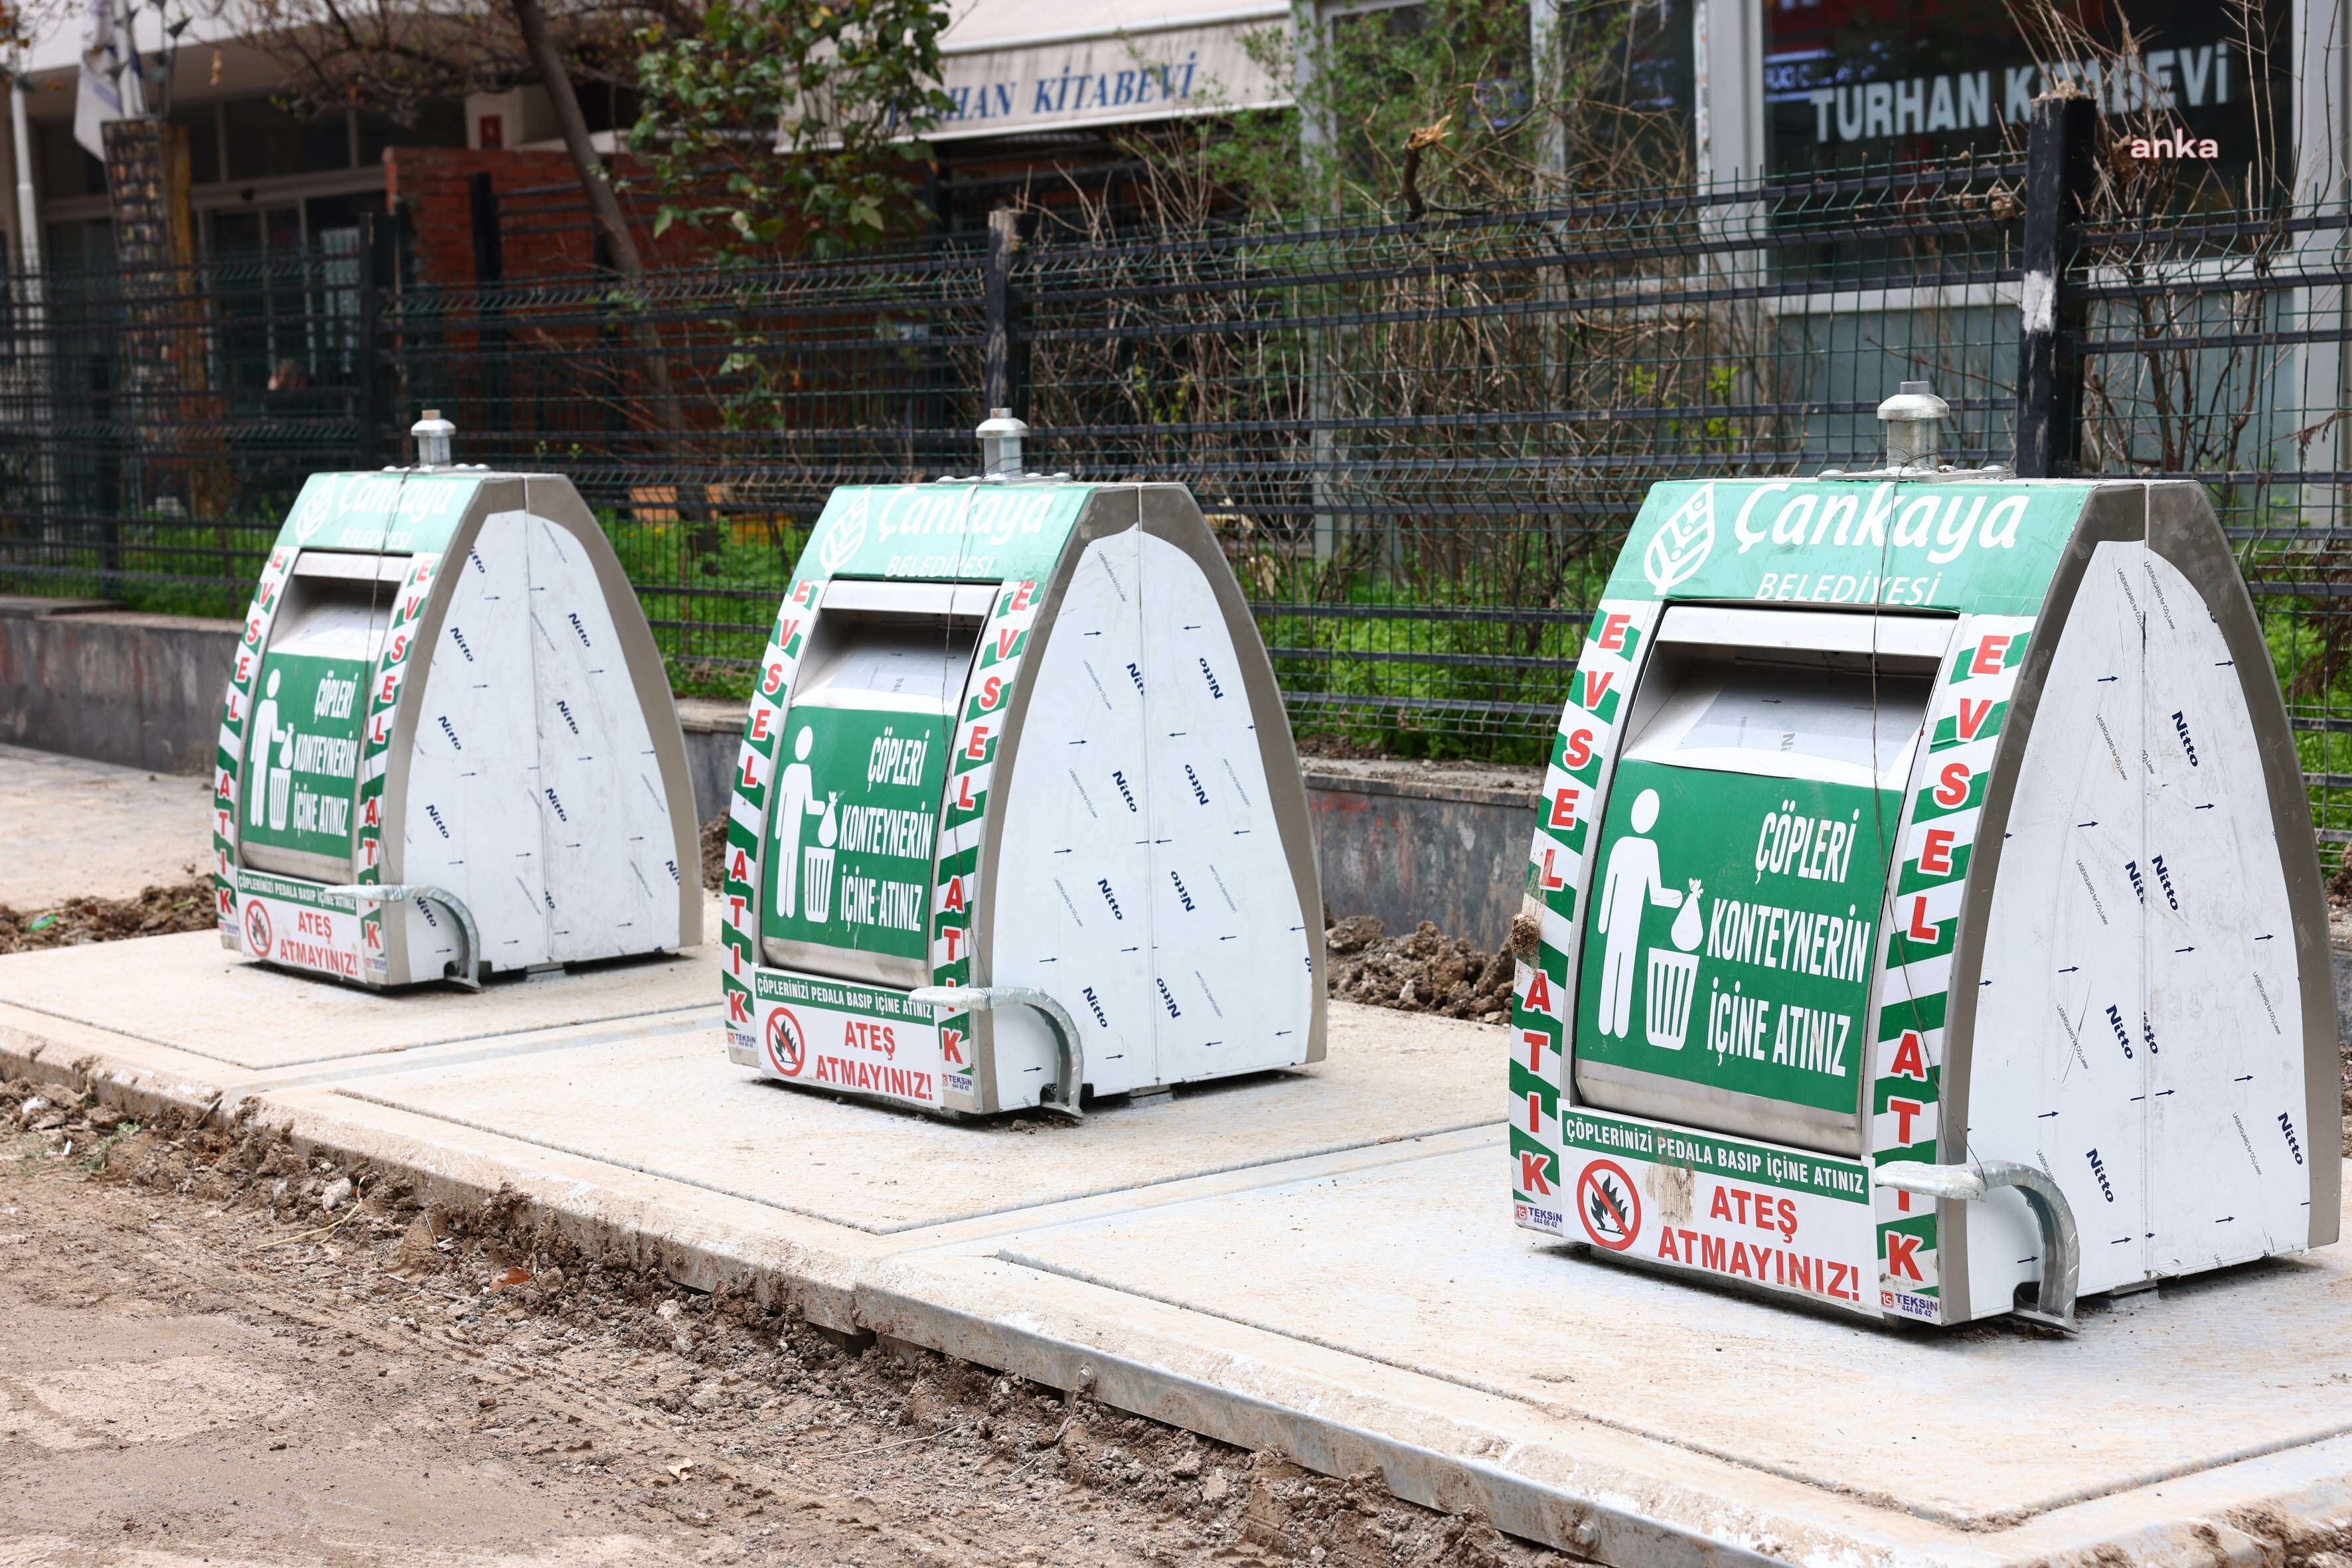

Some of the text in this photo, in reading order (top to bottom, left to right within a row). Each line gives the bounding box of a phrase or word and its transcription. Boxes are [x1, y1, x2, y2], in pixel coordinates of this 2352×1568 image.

[888, 82, 1017, 127] THAN
[1810, 70, 1990, 143] TURHAN
[337, 474, 458, 524] Çankaya
[878, 485, 1055, 546] Çankaya
[1735, 482, 2030, 564] Çankaya
[469, 546, 485, 574] itto
[885, 552, 996, 578] BELEDİYESİ
[1756, 570, 1942, 605] BELEDİYESİ
[450, 627, 473, 662] Nitto
[568, 613, 590, 647] Nitto
[313, 670, 358, 724] ÇÖPLERİ
[1126, 662, 1144, 696] Nit
[1199, 657, 1224, 700] Nitto
[437, 716, 461, 750] Nitto
[556, 700, 579, 735] Nitto
[2171, 710, 2198, 767] Nitto
[293, 730, 358, 779] KONTEYNERİN
[867, 726, 929, 793] ÇÖPLERİ
[545, 788, 567, 822] Nitto
[1112, 770, 1137, 813] Nitto
[1184, 764, 1210, 806] Nitto
[1912, 635, 2010, 941] EVSEL
[293, 782, 349, 838] İÇİNE ATINIZ
[426, 805, 449, 838] Nitto
[839, 801, 934, 860] KONTEYNERİN
[1755, 799, 1859, 884] ÇÖPLERİ
[840, 864, 923, 933] İÇİNE ATINIZ
[1097, 878, 1123, 920] Nitto
[1170, 871, 1196, 912] Nitto
[2124, 860, 2144, 904] Nit
[2151, 854, 2178, 911] Nitto
[298, 911, 332, 945] ATEŞ
[1707, 898, 1870, 984] KONTEYNERİN
[279, 939, 358, 976] ATMAYINIZ!
[757, 974, 932, 1019] ÇÖPLERİNİZİ PEDALA BASIP İÇİNE ATINIZ
[1082, 986, 1108, 1028] Nitto
[1156, 978, 1182, 1019] Nitto
[844, 1020, 896, 1061] ATEŞ
[1707, 978, 1851, 1077] İÇİNE ATINIZ
[2105, 1004, 2133, 1059] Nitto
[817, 1055, 933, 1100] ATMAYINIZ!
[1567, 1117, 1864, 1194] ÇÖPLERİNİZİ PEDALA BASIP İÇİNE ATINIZ
[2277, 1111, 2303, 1165] Nitto
[2085, 1148, 2114, 1203] Nitto
[1710, 1185, 1798, 1243] ATEŞ
[1658, 1227, 1859, 1302] ATMAYINIZ!
